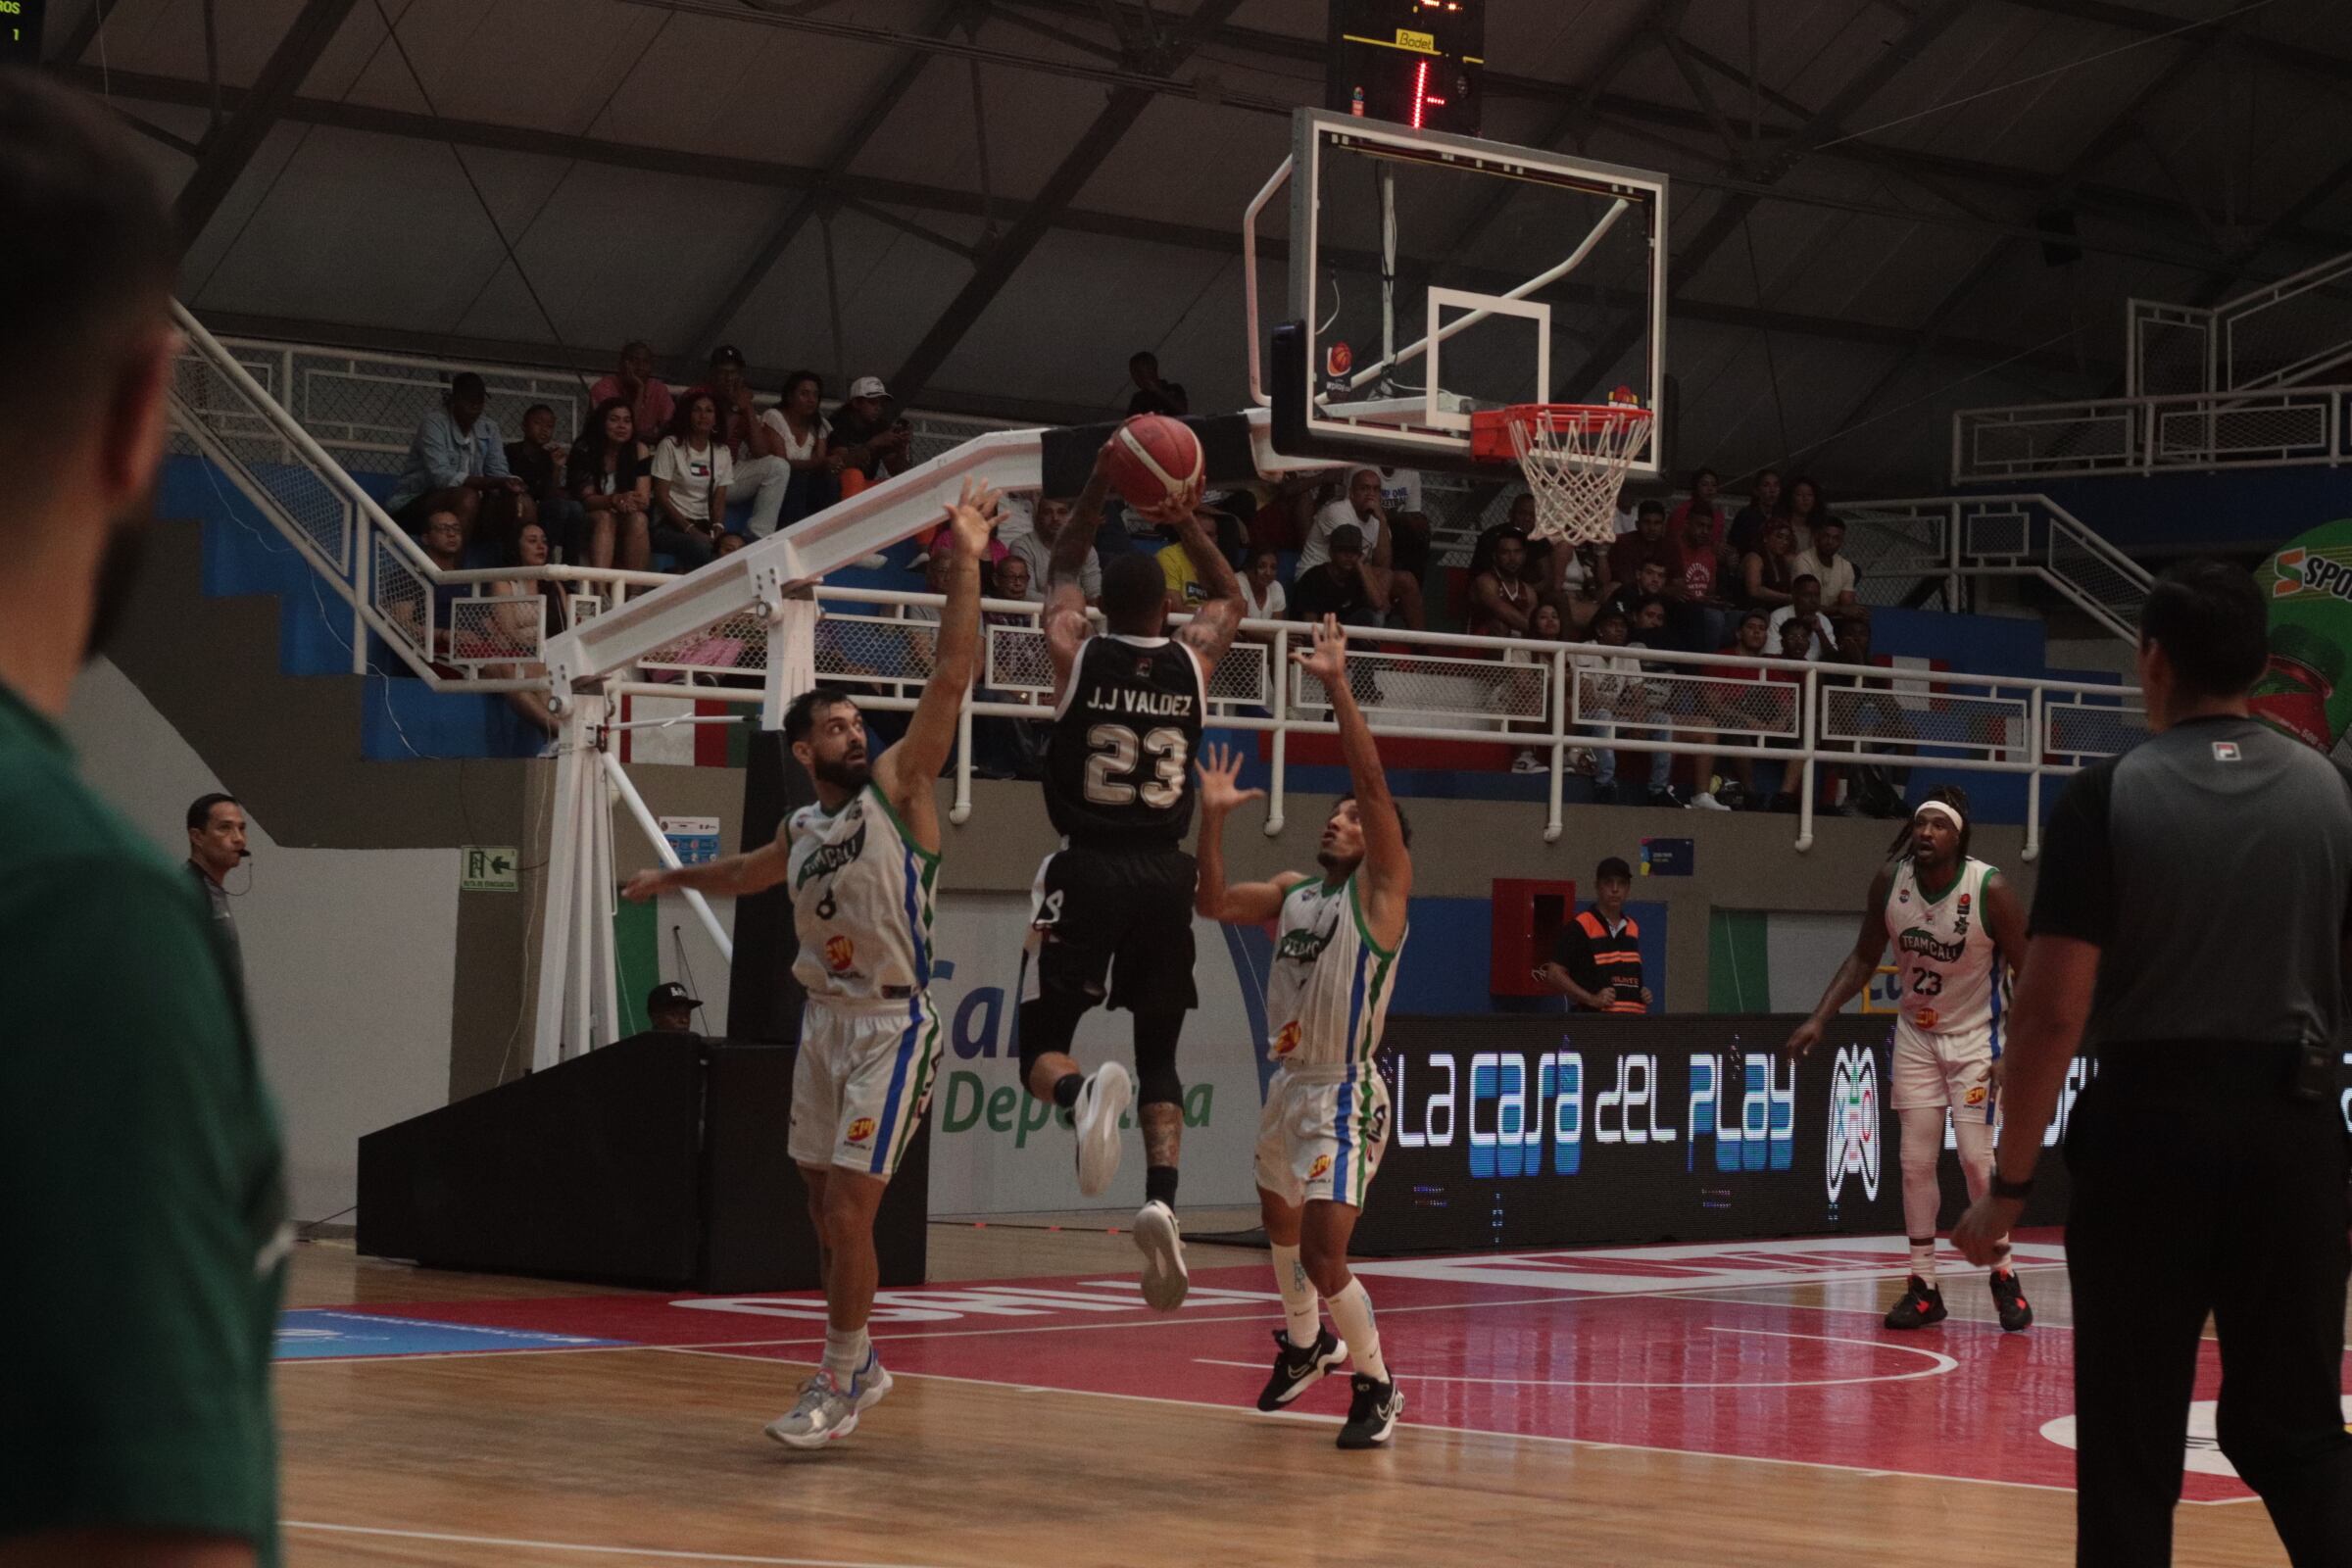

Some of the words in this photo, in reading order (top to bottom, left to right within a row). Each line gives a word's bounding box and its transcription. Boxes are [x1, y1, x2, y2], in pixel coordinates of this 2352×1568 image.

[1399, 32, 1433, 50] Bodet
[2304, 556, 2352, 601] SPO
[1087, 687, 1118, 710] J.J
[1124, 690, 1193, 716] VALDEZ
[1084, 723, 1189, 808] 23
[1913, 967, 1941, 996] 23
